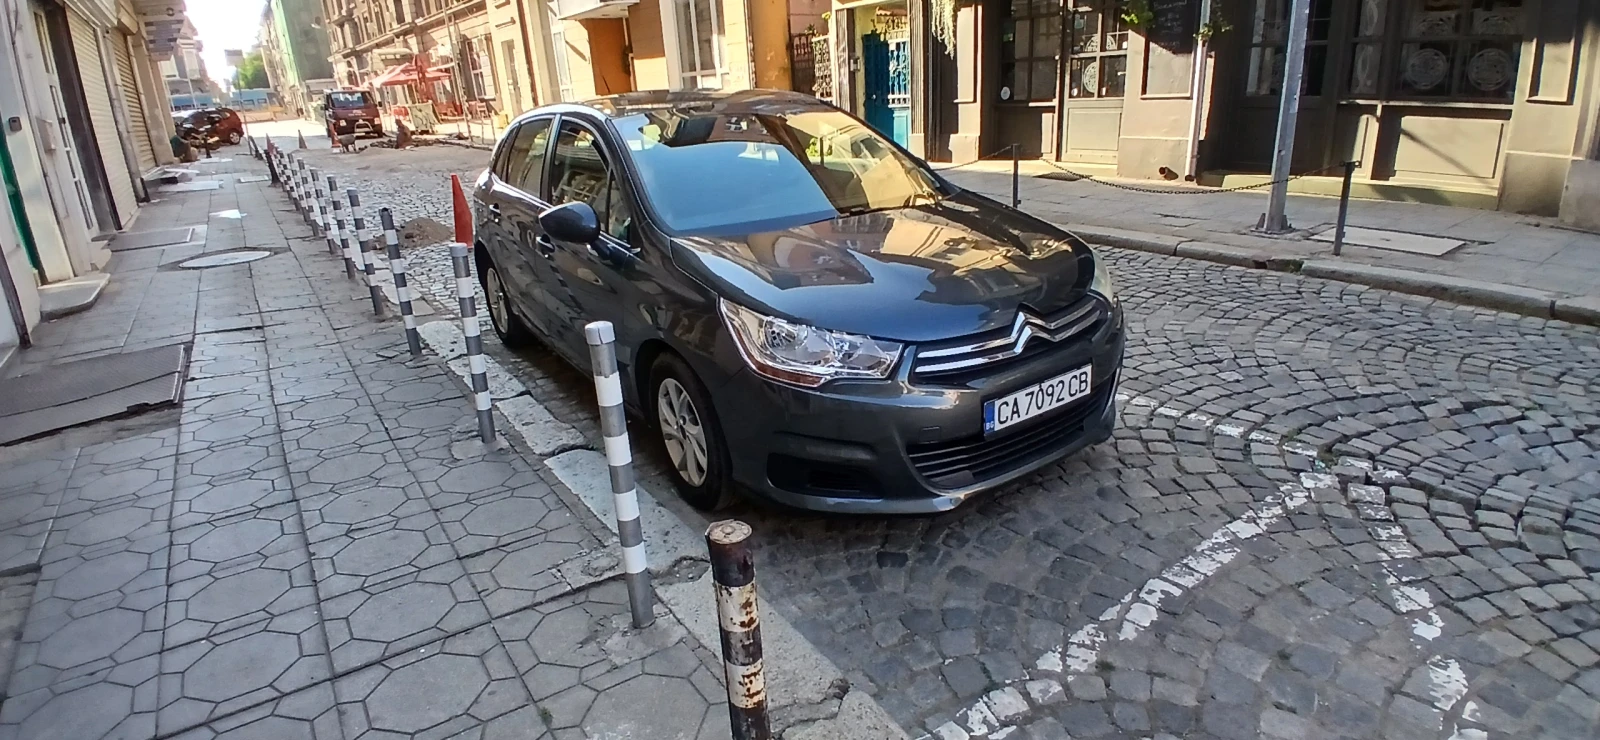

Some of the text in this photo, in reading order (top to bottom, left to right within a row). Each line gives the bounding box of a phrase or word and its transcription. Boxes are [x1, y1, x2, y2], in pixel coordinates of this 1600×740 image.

[997, 371, 1088, 425] CA 7092 CB
[985, 421, 995, 431] BG
